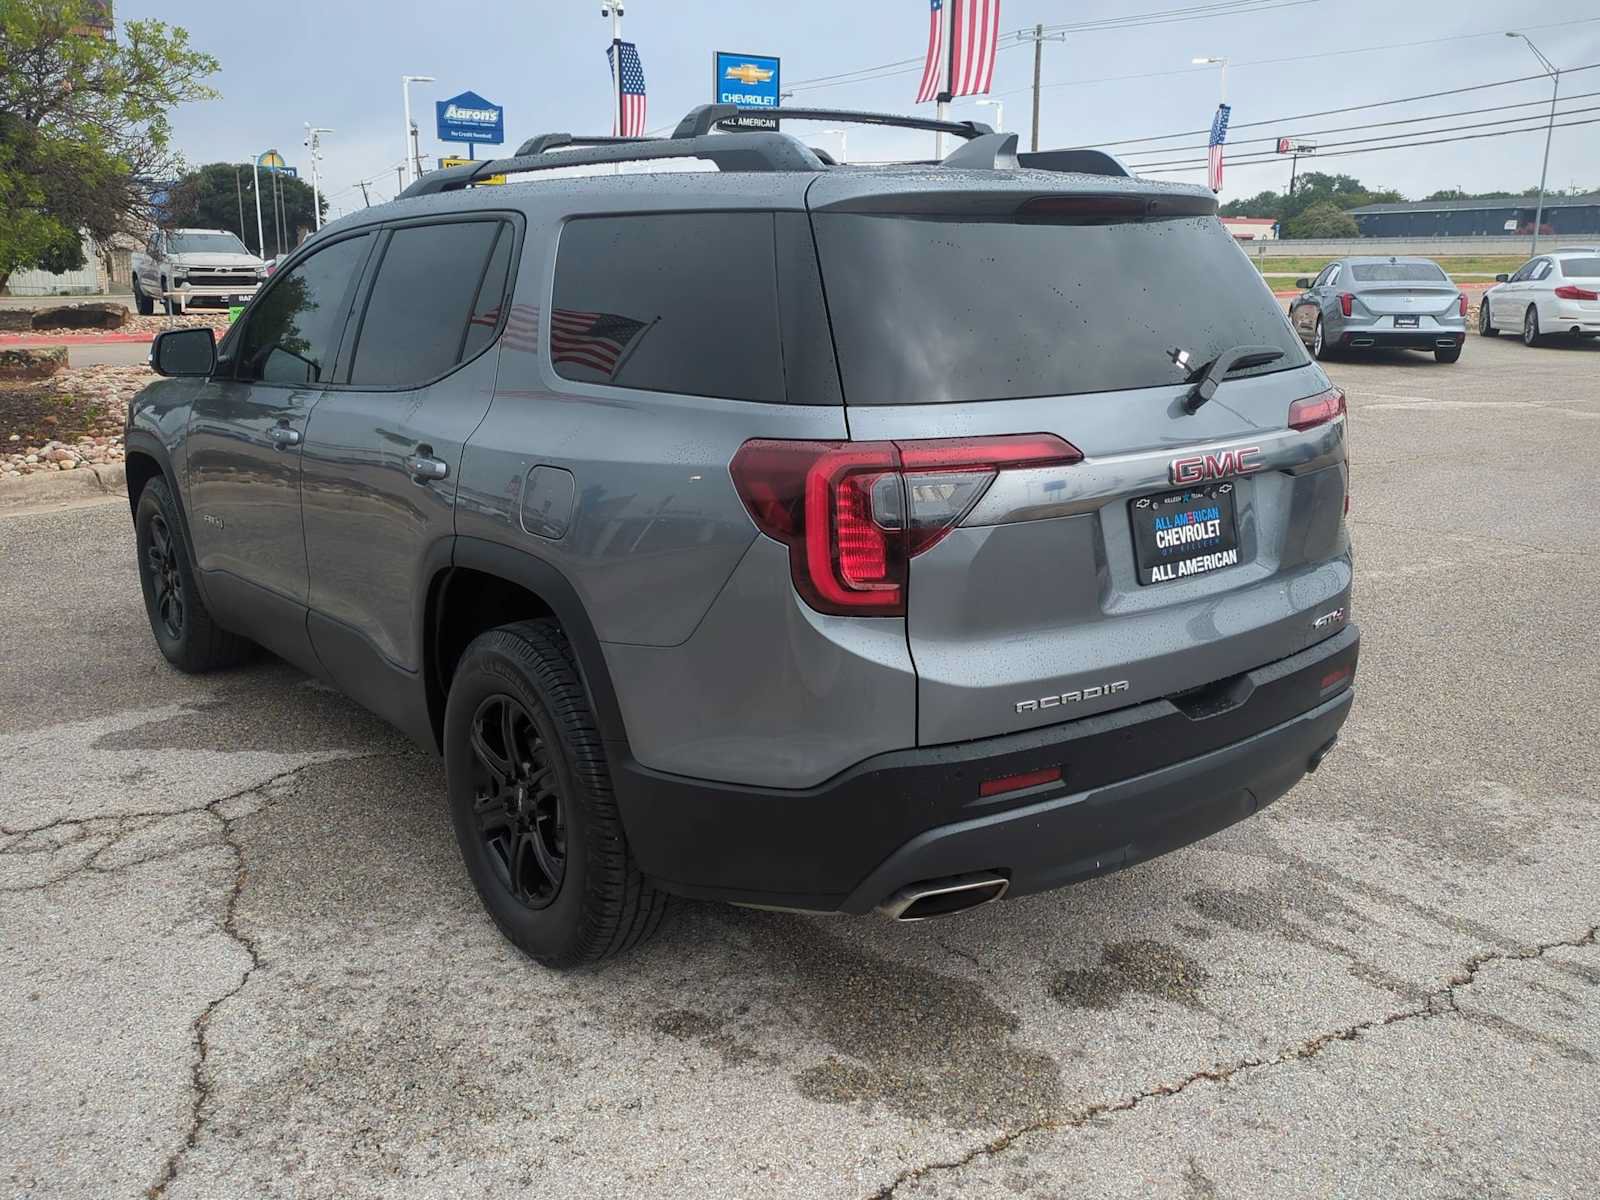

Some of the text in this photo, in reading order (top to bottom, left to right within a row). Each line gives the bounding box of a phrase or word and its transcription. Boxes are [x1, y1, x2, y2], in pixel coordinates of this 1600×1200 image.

[722, 93, 776, 105] CHEVROLET
[444, 104, 499, 122] Aaron's
[738, 117, 776, 128] AMERICAN
[1171, 447, 1262, 486] GMC
[1155, 507, 1219, 531] ALL AMERICAN
[1156, 519, 1221, 549] CHEVROLET
[1151, 549, 1239, 583] ALL AMERICAN
[1015, 680, 1130, 713] ACADIA
